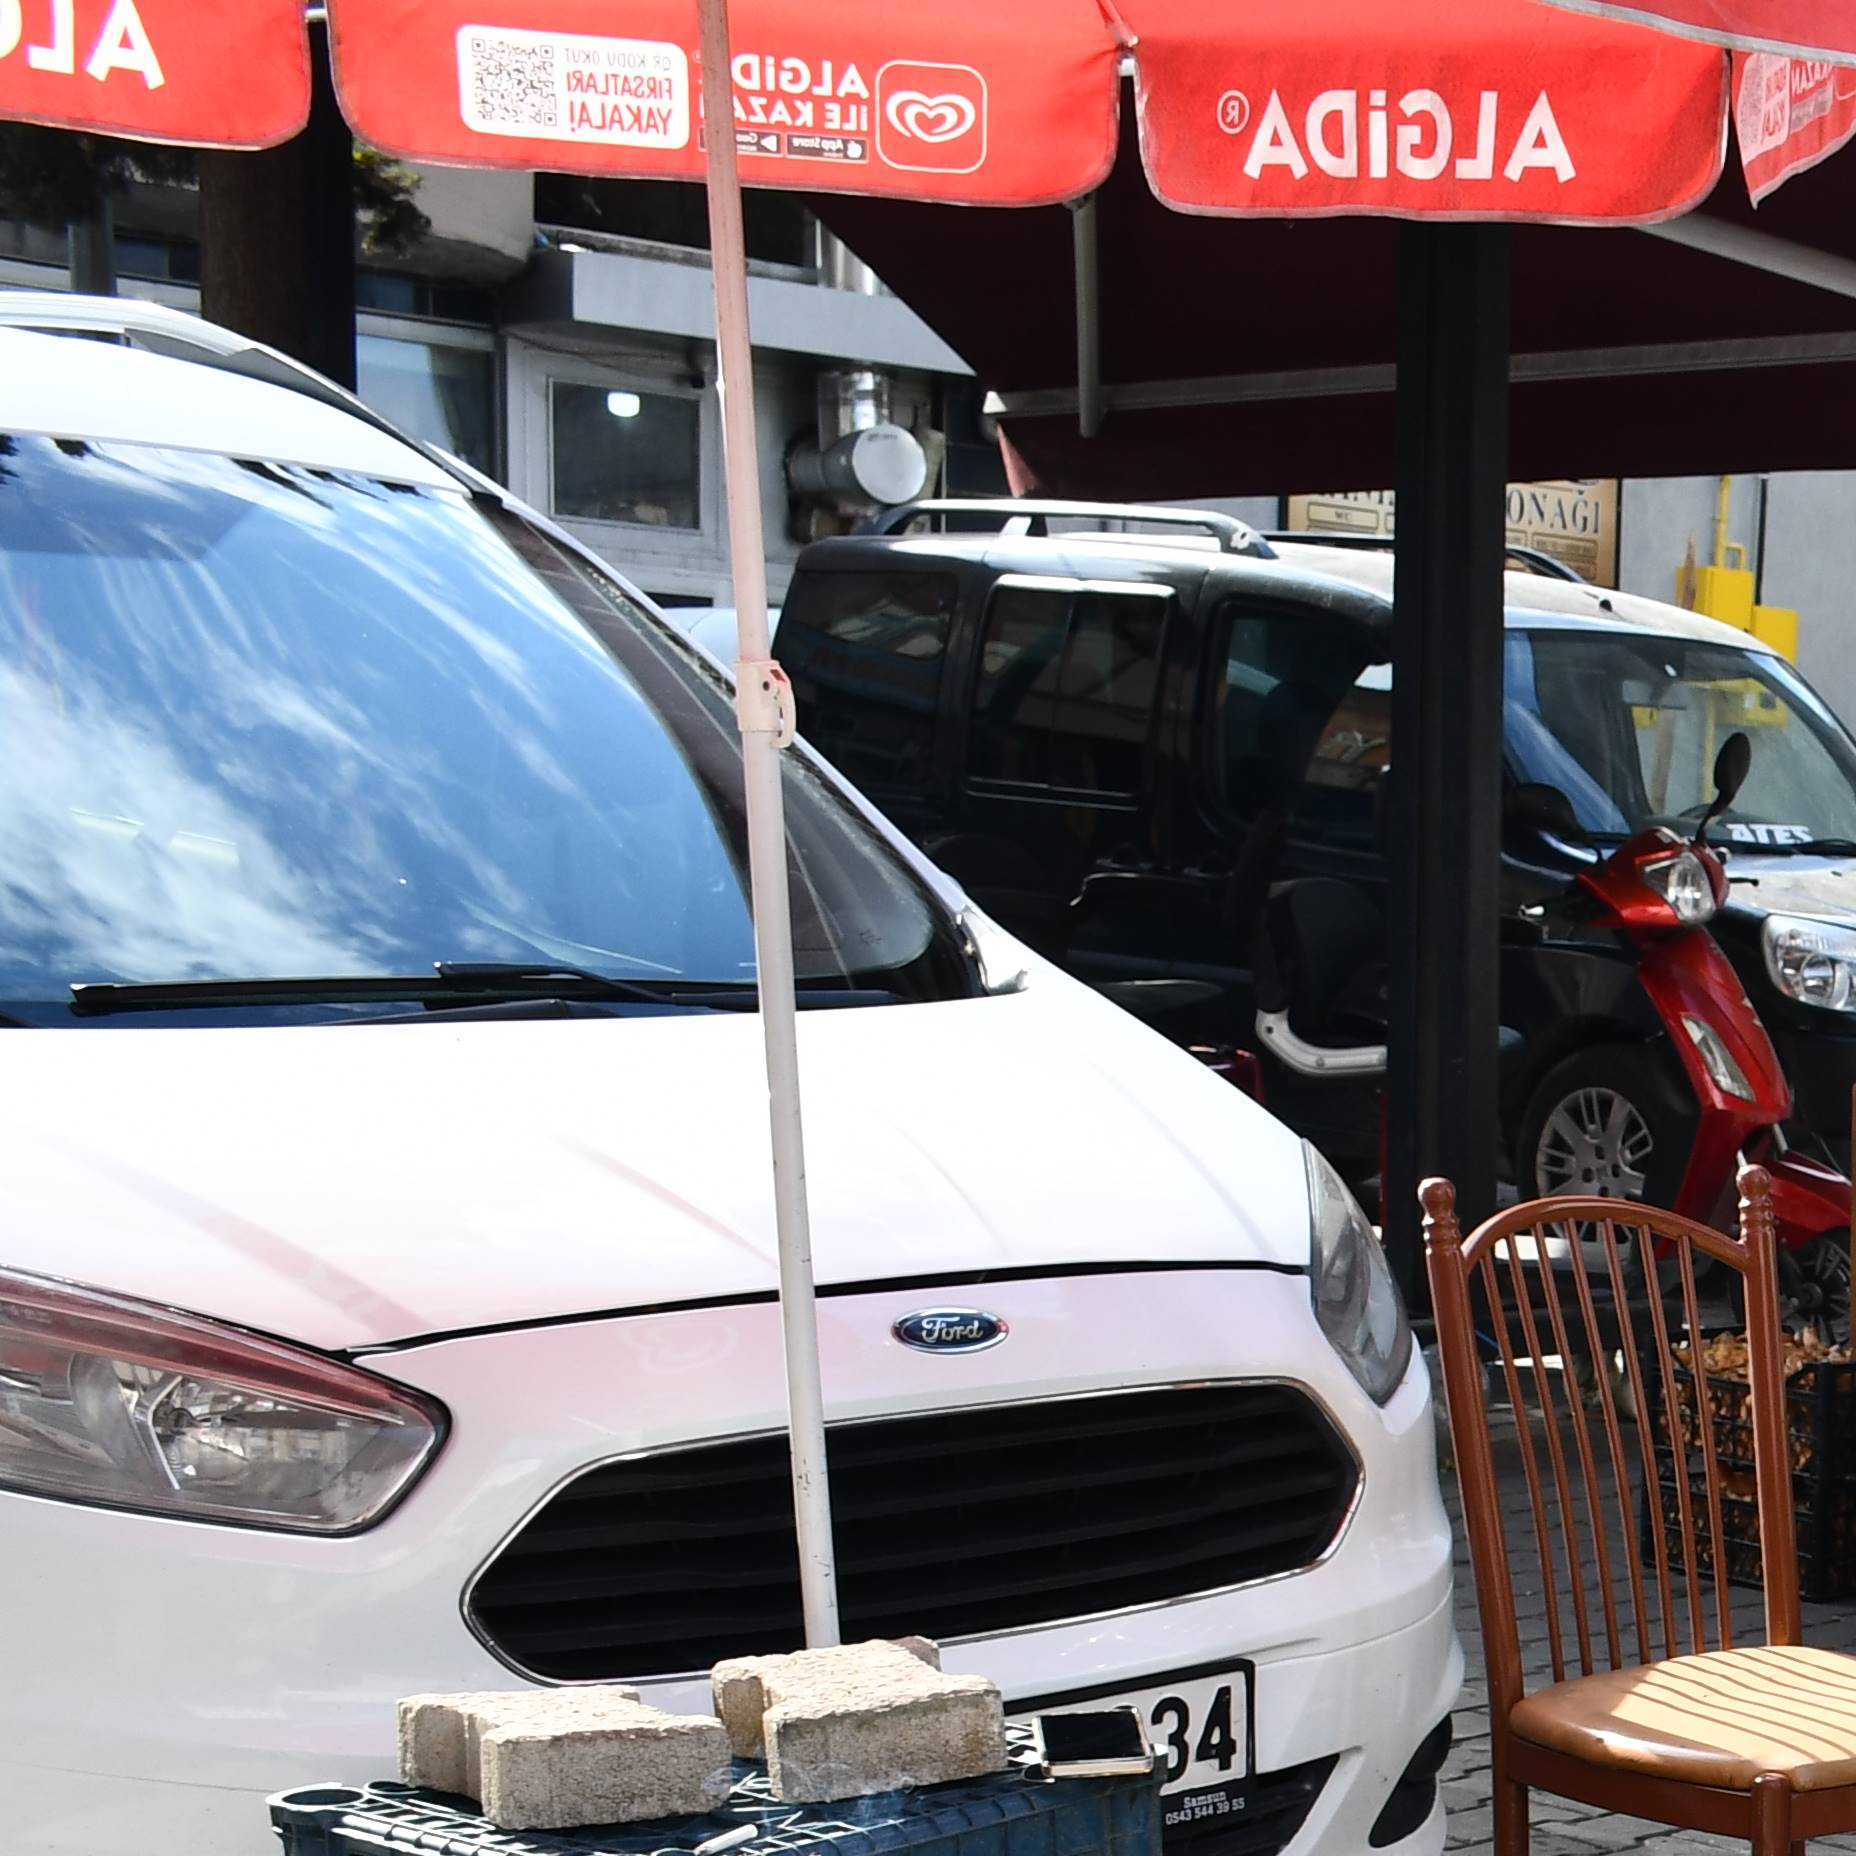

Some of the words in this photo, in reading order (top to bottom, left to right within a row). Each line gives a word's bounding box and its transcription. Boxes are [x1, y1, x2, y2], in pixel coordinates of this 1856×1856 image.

[1506, 489, 1599, 533] ONAĞI
[921, 1316, 983, 1343] Ford
[1183, 1791, 1227, 1809] Samsun
